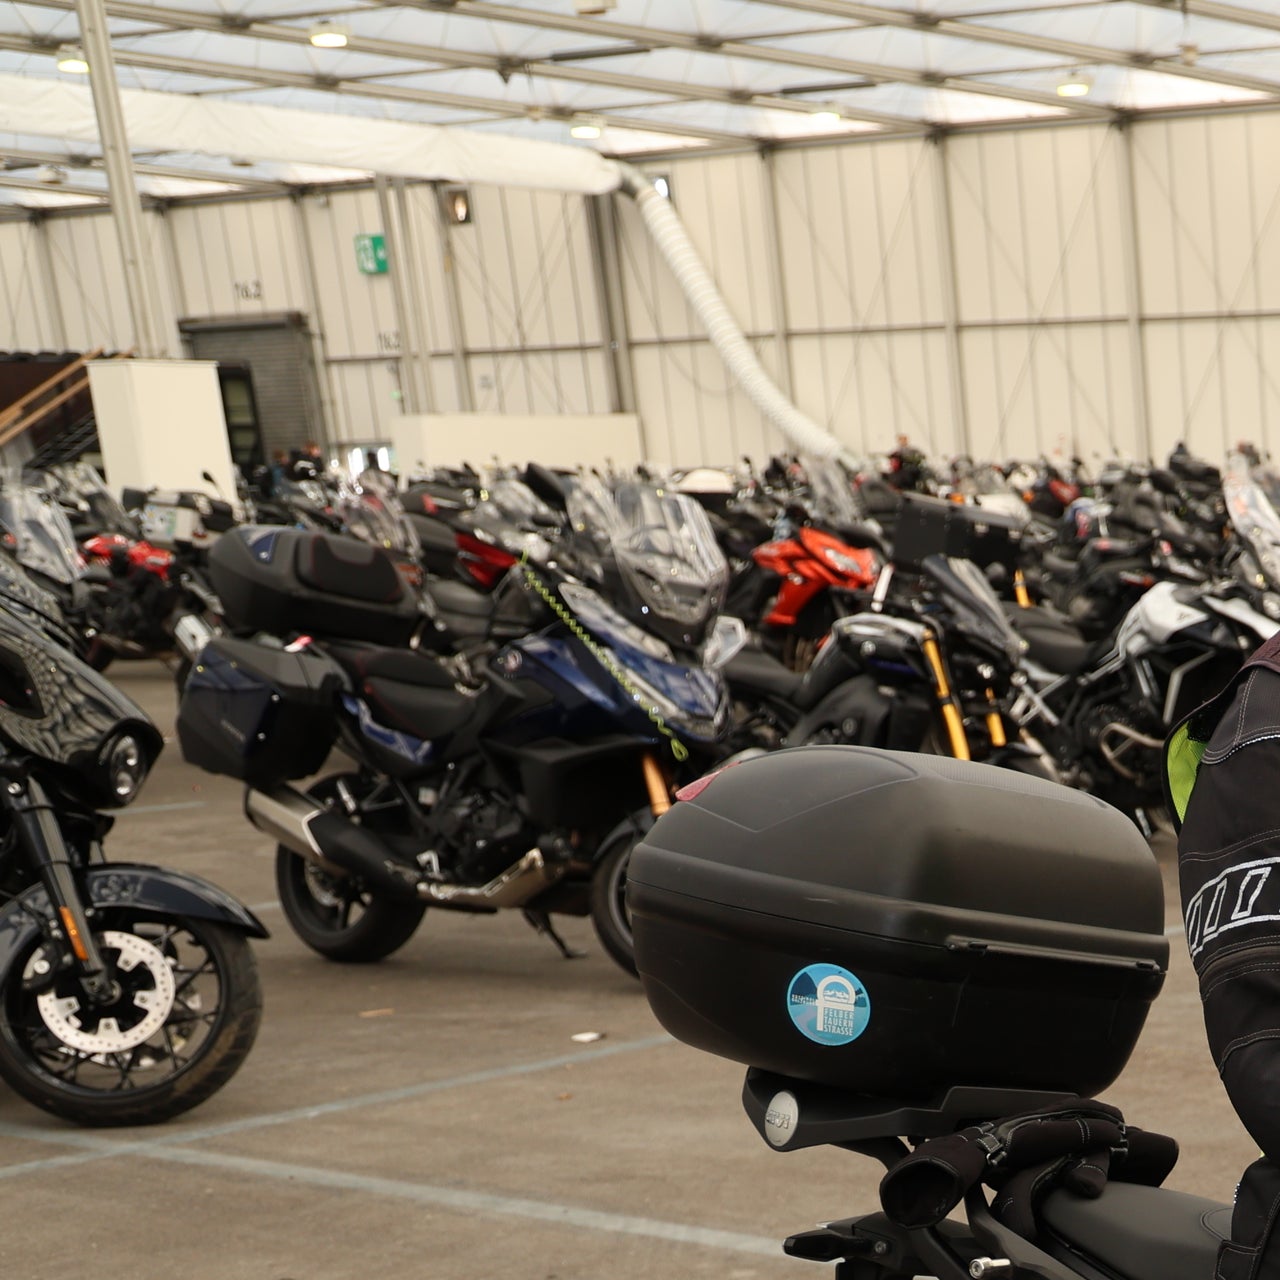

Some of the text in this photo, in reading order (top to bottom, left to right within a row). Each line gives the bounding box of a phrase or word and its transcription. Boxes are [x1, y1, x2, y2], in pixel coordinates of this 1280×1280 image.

[824, 1007, 855, 1020] FELBER
[824, 1016, 854, 1028] TAUERN
[823, 1024, 853, 1036] STRASSE
